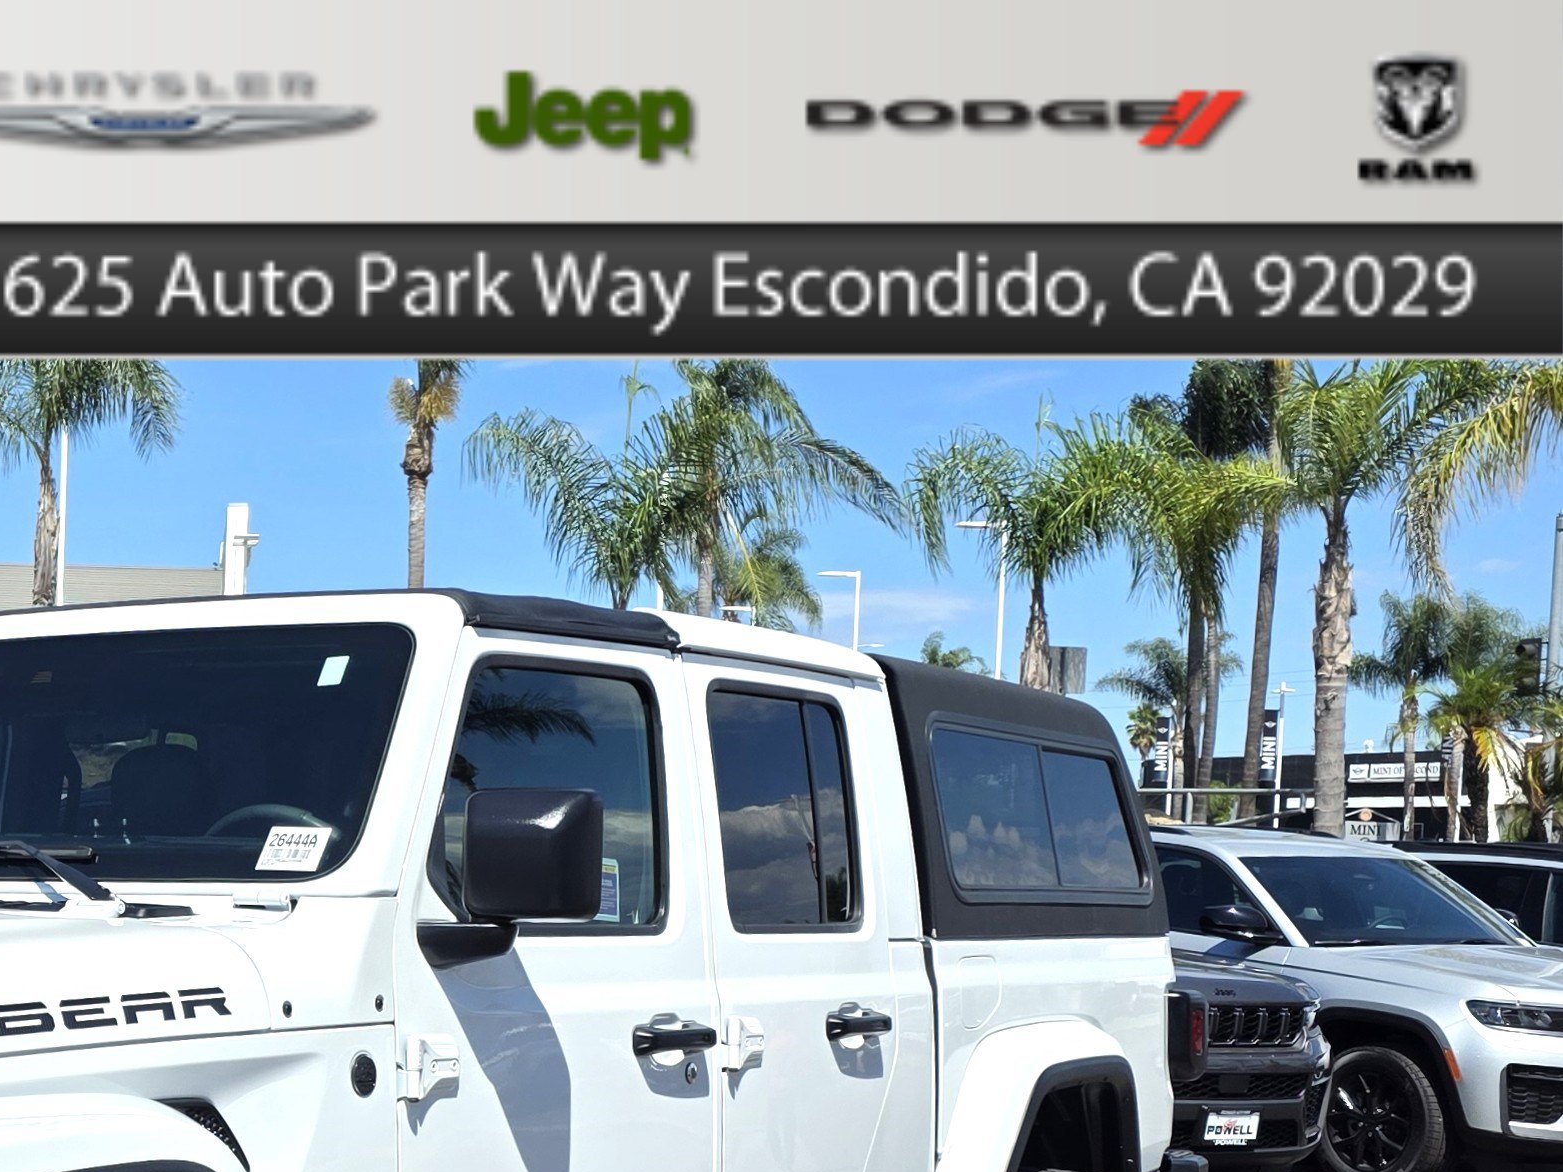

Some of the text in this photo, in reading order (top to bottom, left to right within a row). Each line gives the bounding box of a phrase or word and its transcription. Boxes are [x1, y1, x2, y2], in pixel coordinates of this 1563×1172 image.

[1154, 741, 1169, 771] MINI
[1261, 736, 1277, 770] MINI
[1350, 824, 1383, 836] MINI
[268, 833, 318, 848] 26444A
[1207, 1125, 1253, 1136] POWELL
